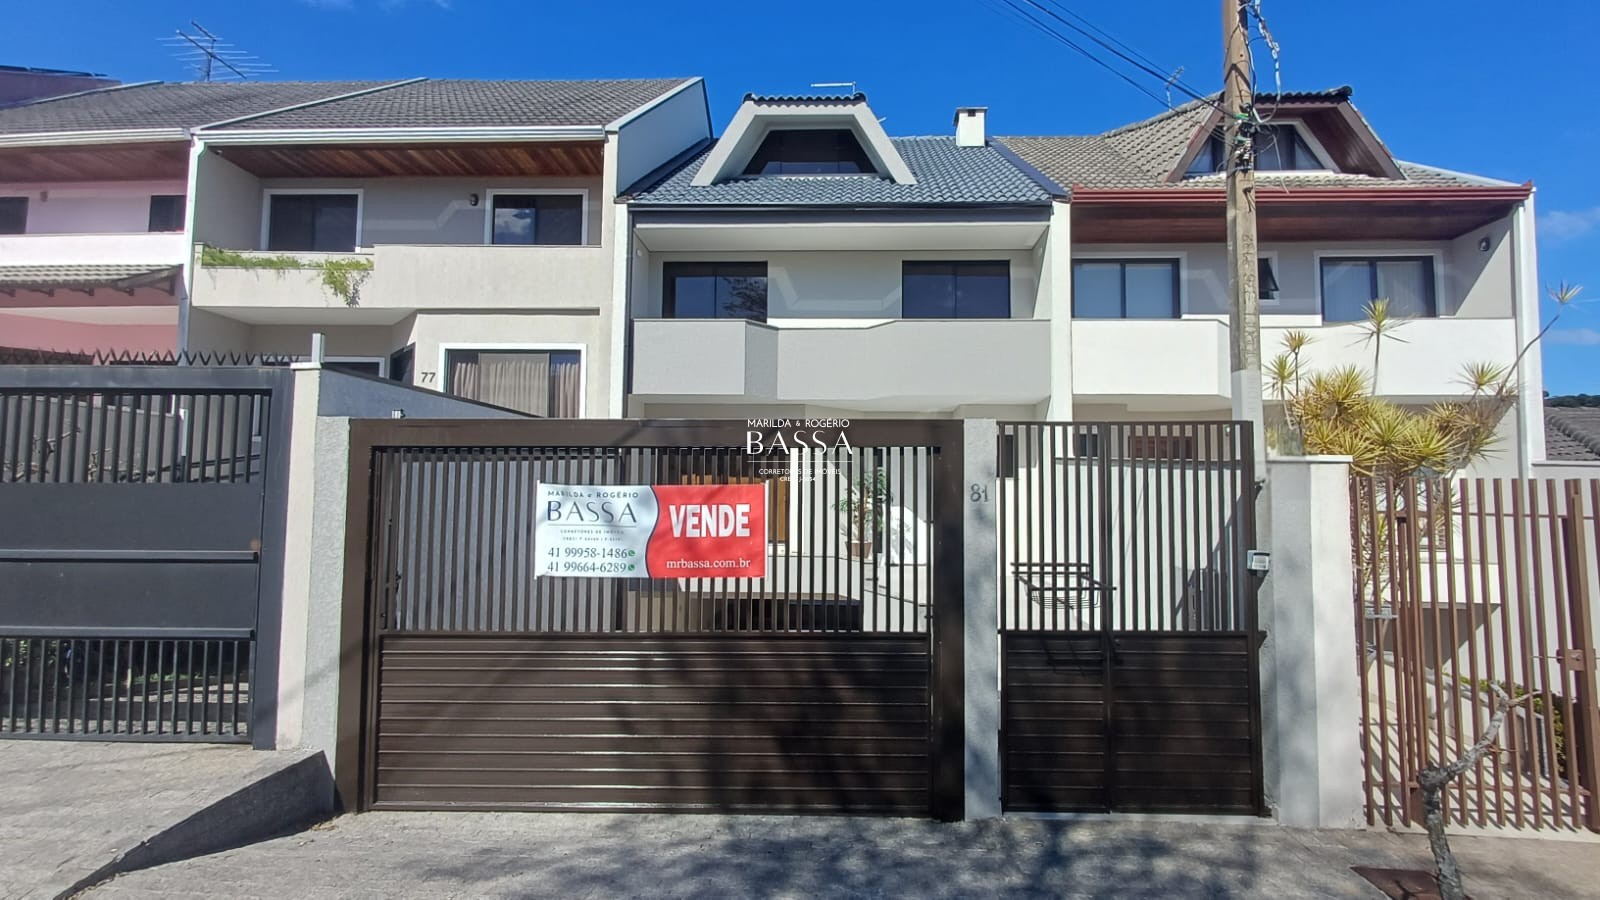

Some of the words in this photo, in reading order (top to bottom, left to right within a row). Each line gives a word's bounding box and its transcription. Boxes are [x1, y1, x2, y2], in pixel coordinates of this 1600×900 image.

[421, 371, 436, 383] 77
[547, 490, 585, 498] MARILDA
[970, 483, 988, 503] 81
[547, 500, 637, 524] BASSA
[669, 503, 751, 538] VENDE
[547, 547, 560, 557] 41
[564, 547, 628, 559] 99958-1486
[547, 561, 559, 572] 41
[563, 561, 627, 573] 99664-6289
[666, 557, 751, 569] mrbassa.com.br
